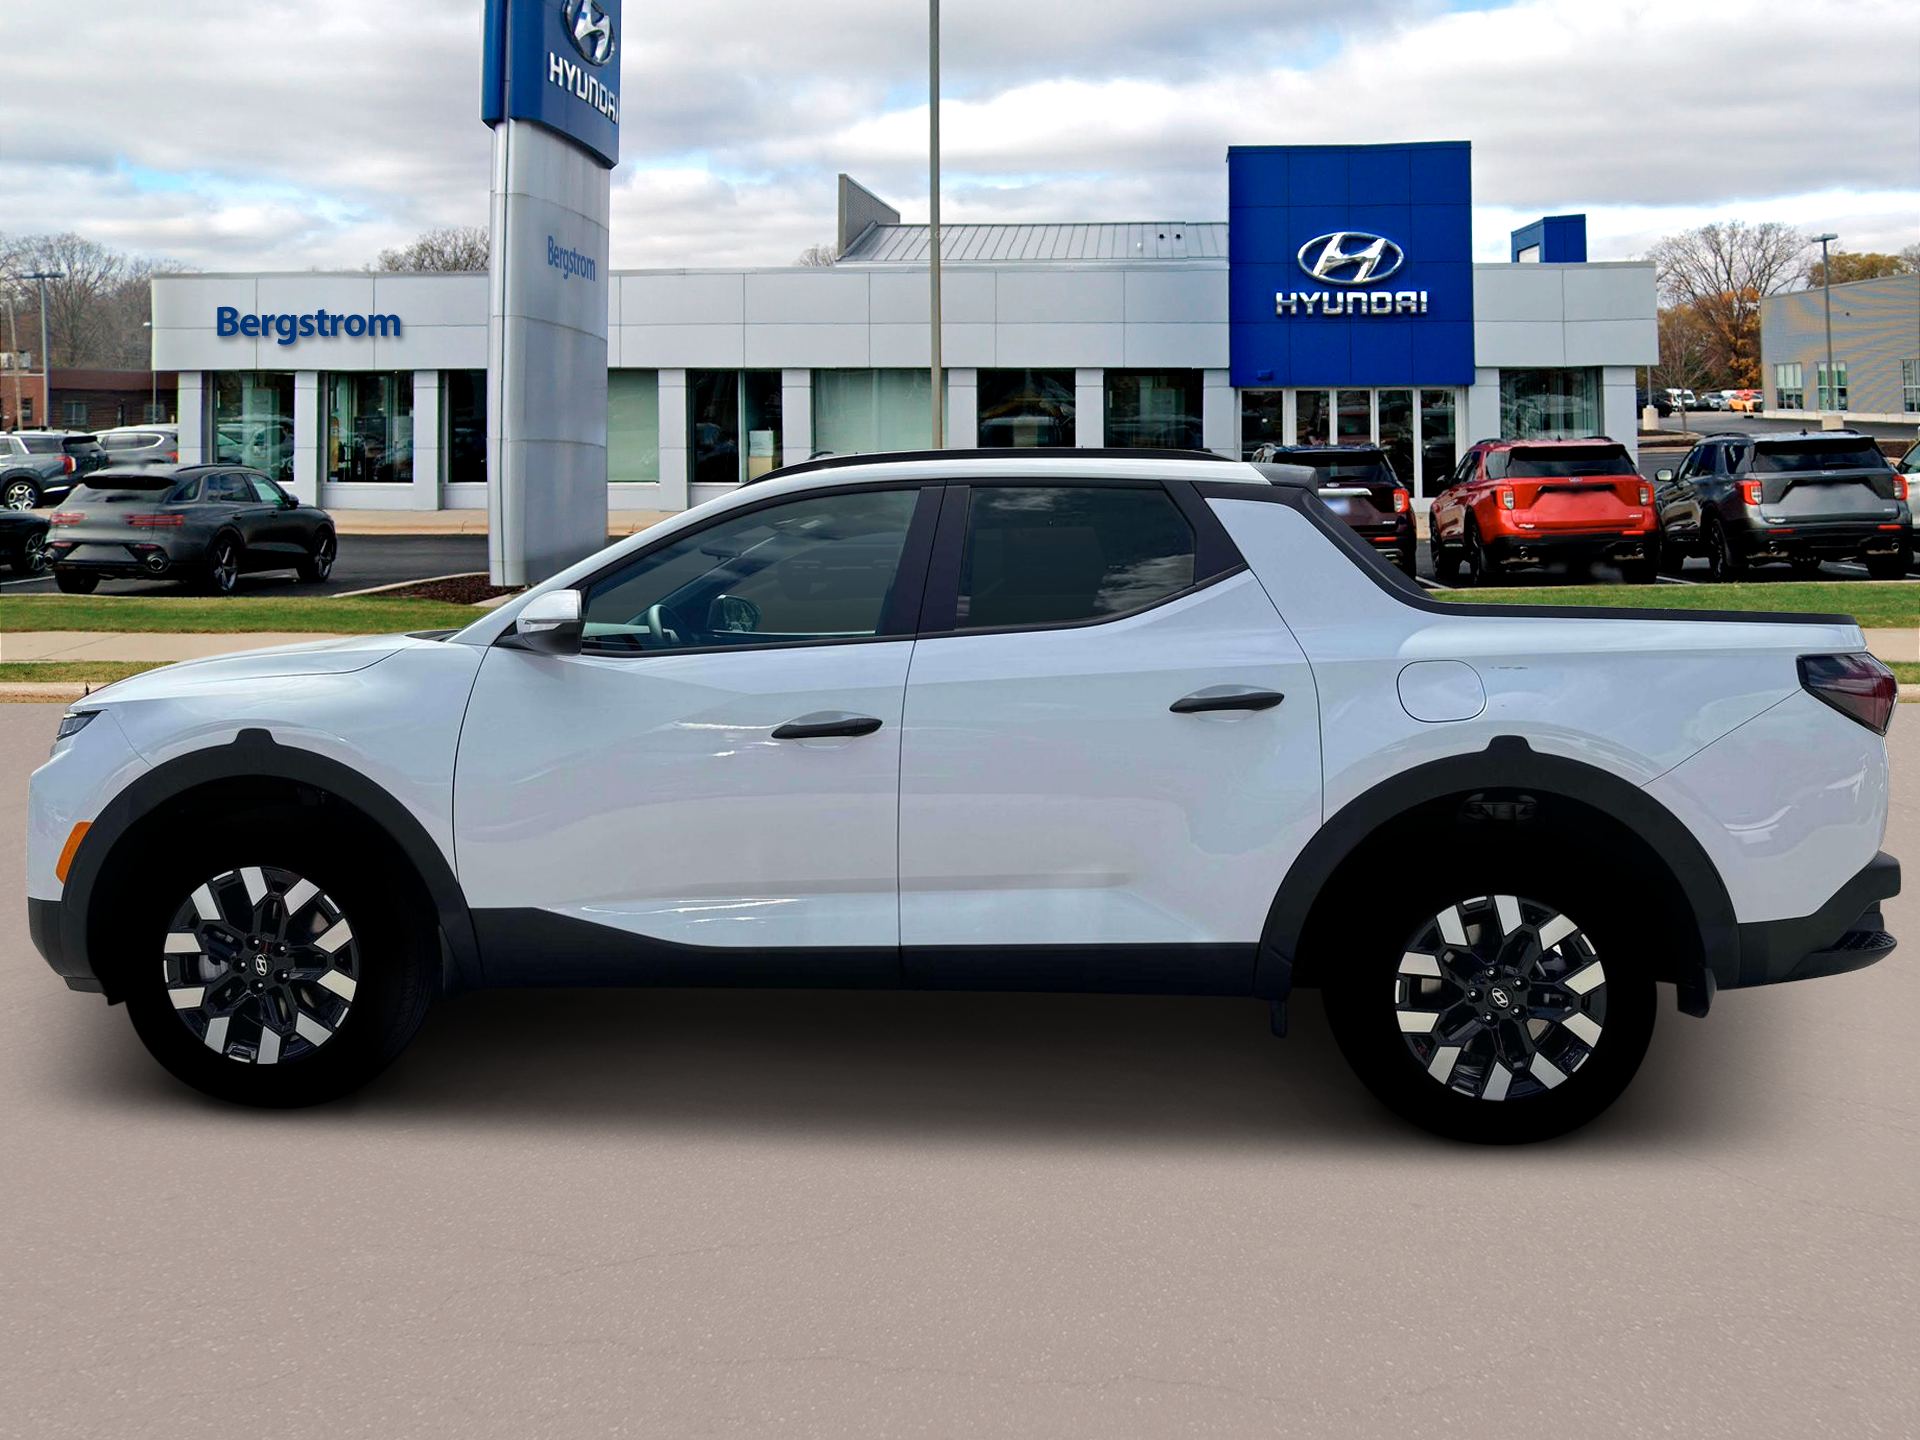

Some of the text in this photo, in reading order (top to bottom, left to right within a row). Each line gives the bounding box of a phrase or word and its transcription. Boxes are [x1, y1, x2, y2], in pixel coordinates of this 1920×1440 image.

[549, 51, 619, 124] HYUNDAI
[547, 235, 596, 282] Bergstrom
[1275, 291, 1428, 315] HYUNDAI
[216, 306, 402, 346] Bergstrom
